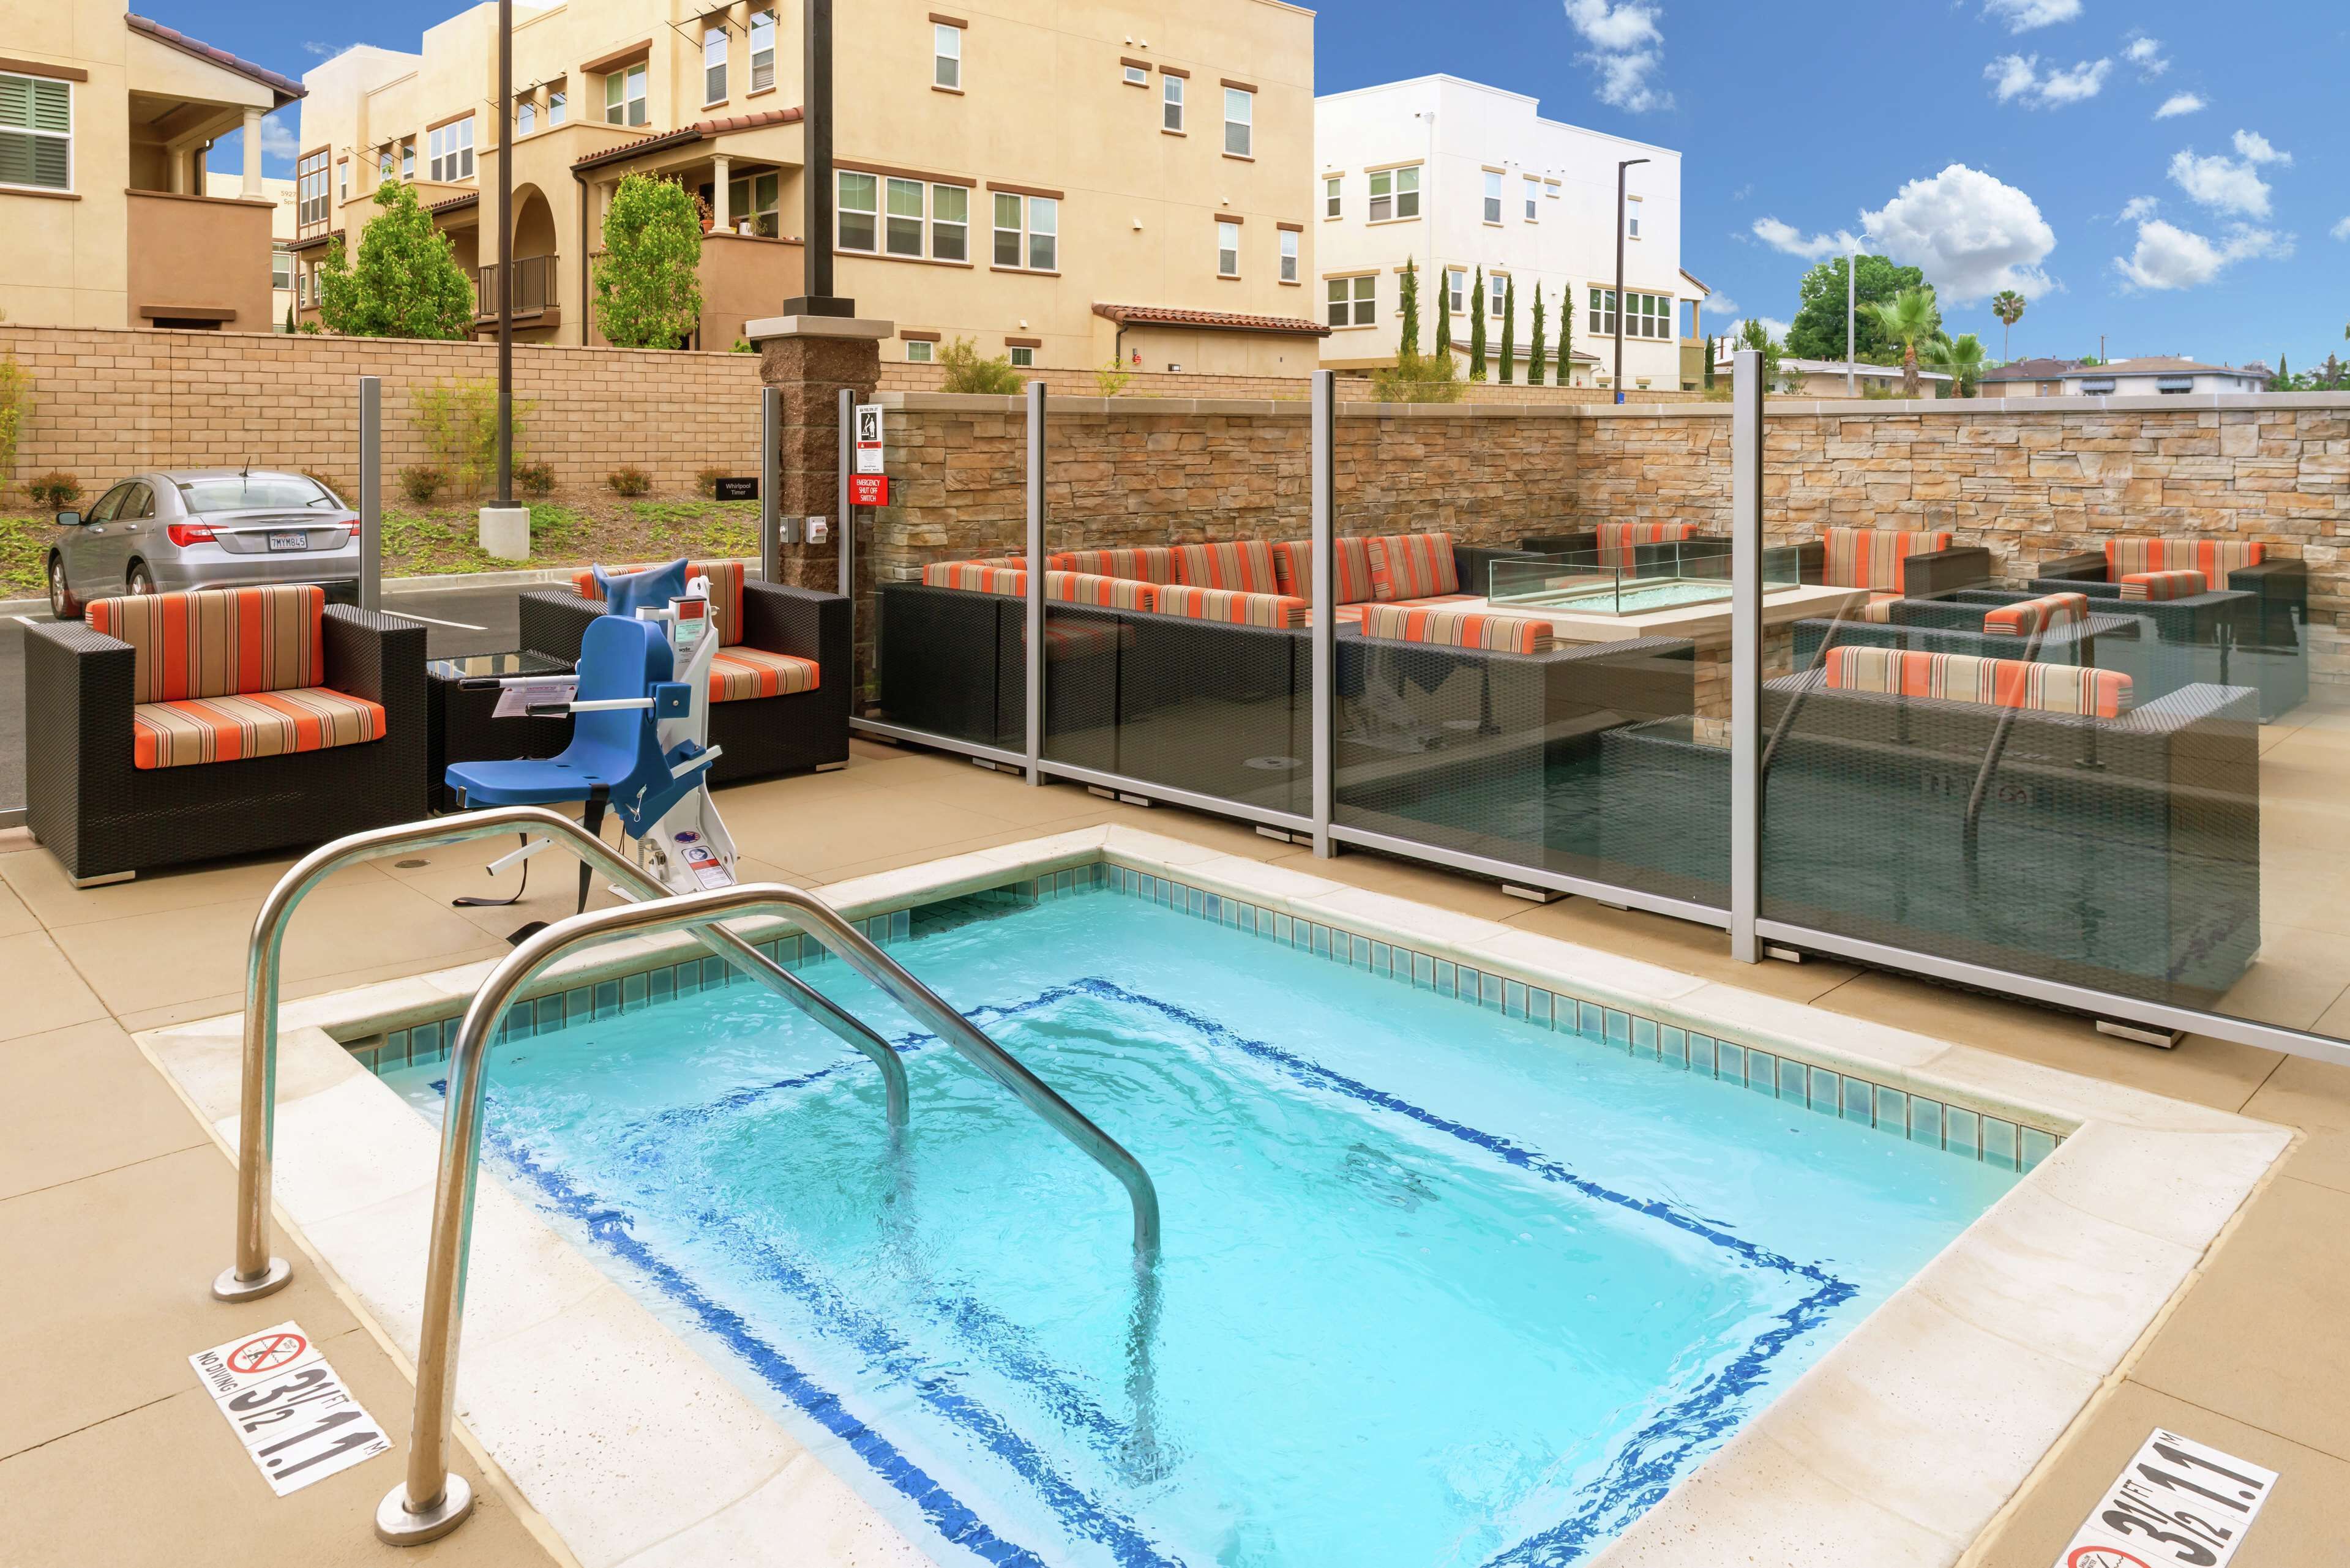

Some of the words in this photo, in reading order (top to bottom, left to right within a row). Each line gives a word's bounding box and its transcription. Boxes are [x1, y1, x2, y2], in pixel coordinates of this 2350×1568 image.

[196, 1351, 220, 1365] NO
[206, 1363, 238, 1392] DIVING
[321, 1394, 350, 1409] FT
[2158, 1432, 2183, 1446] M
[363, 1441, 387, 1455] M
[2123, 1479, 2153, 1498] FT
